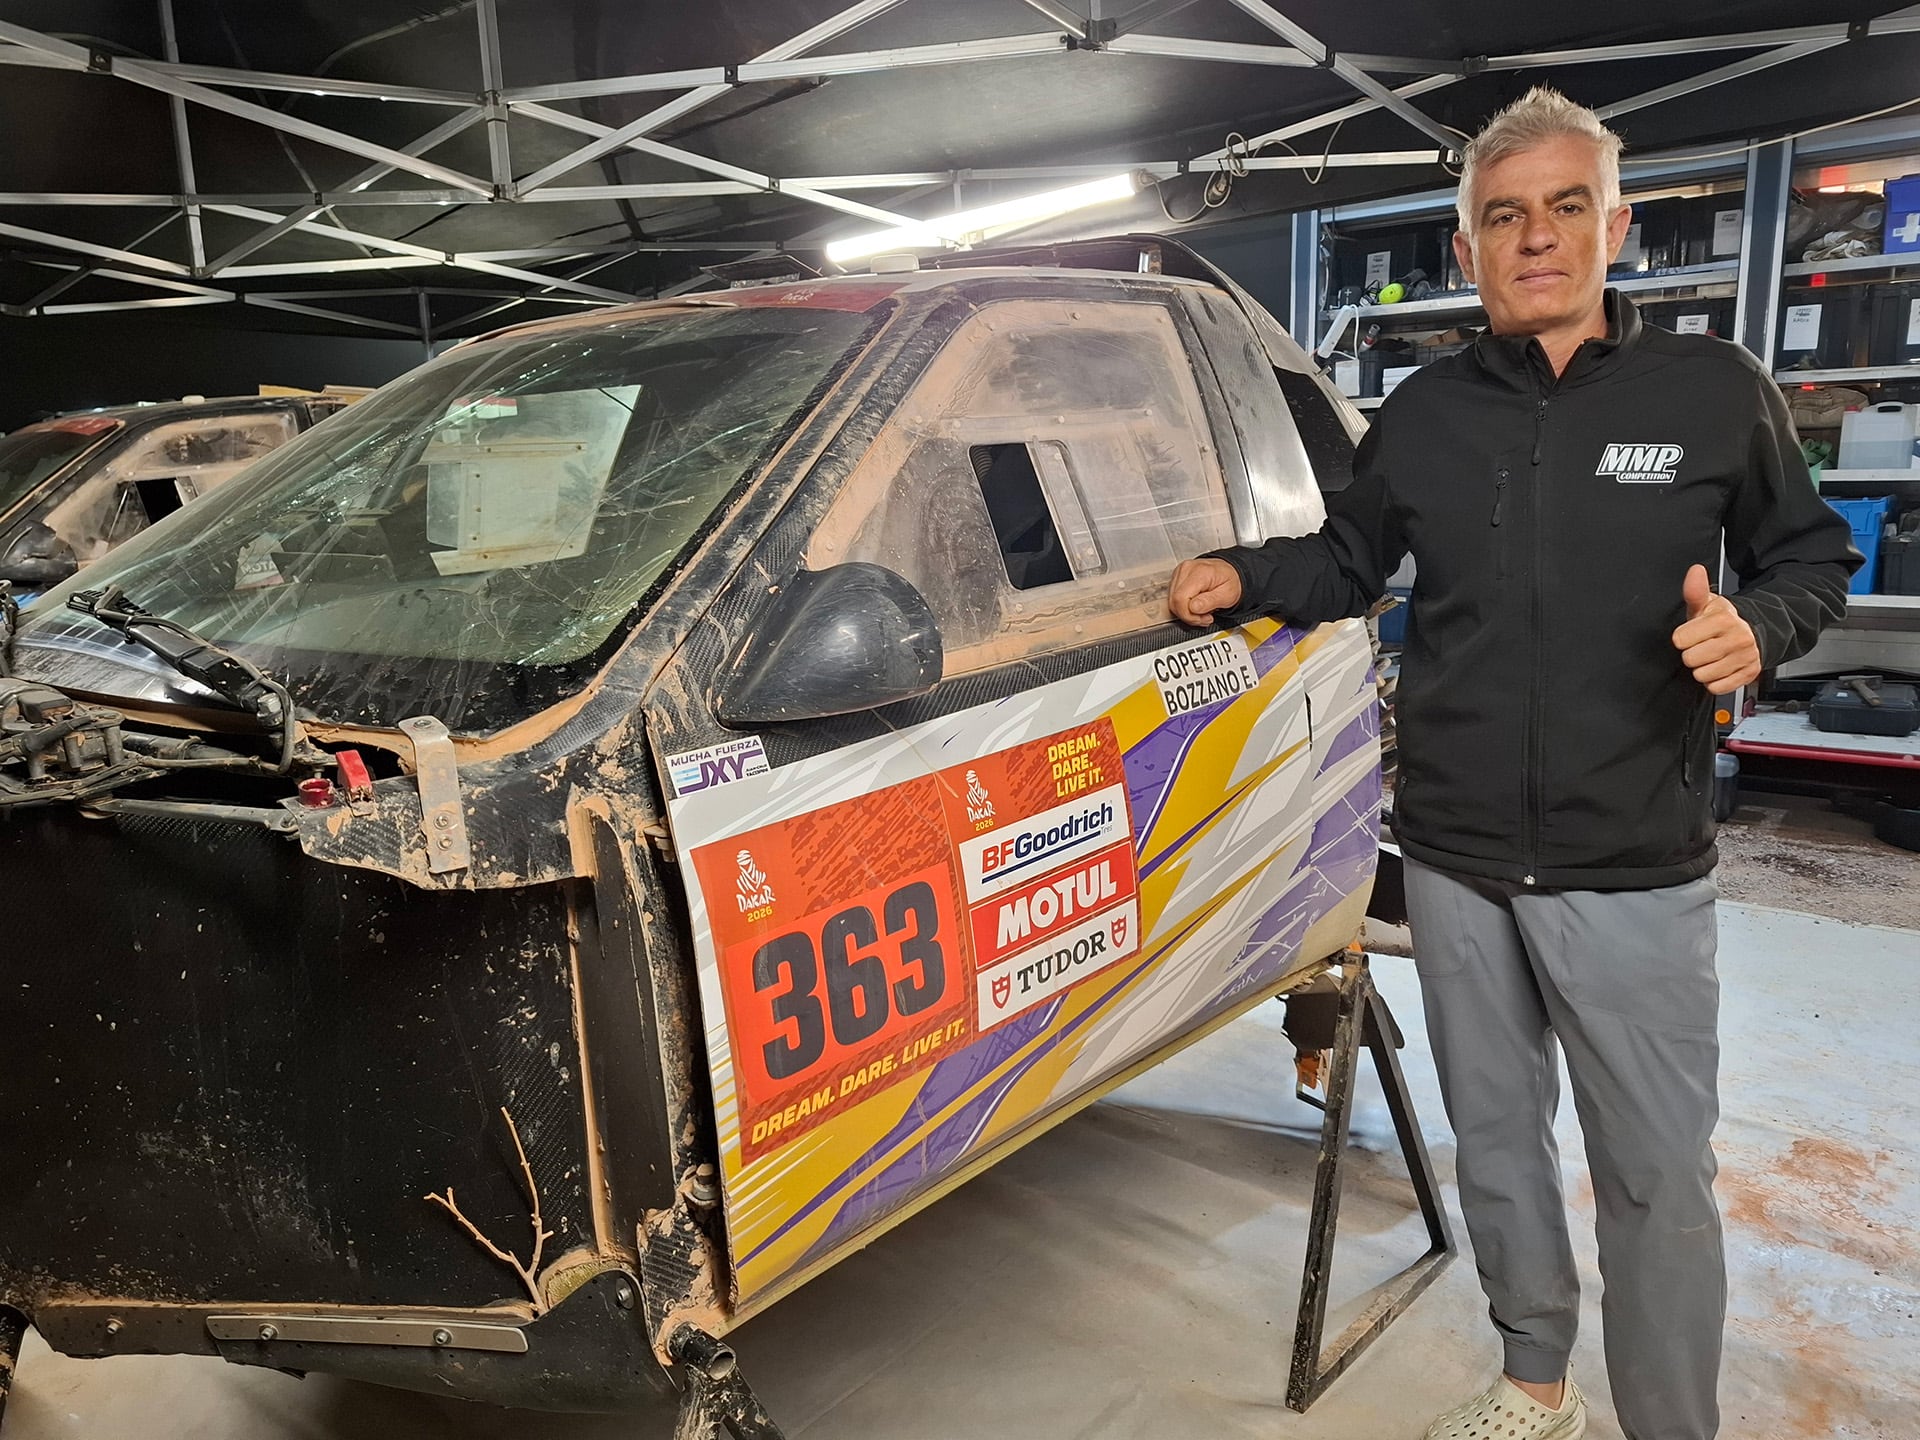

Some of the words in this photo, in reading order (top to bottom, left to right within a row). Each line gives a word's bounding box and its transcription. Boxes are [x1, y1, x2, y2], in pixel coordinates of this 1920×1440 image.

[1600, 446, 1681, 472] MMP
[1619, 472, 1672, 481] COMPETITION
[1153, 643, 1224, 683] COPETTI
[1220, 640, 1238, 664] P.
[1164, 670, 1240, 715] BOZZANO
[1239, 665, 1258, 690] E.
[670, 751, 712, 768] MUCHA
[715, 739, 760, 756] FUERZA
[1047, 732, 1101, 763] DREAM.
[678, 748, 764, 796] JXY
[1052, 753, 1094, 781] DARE.
[1056, 773, 1087, 798] LIVE
[1088, 767, 1105, 786] IT.
[966, 800, 997, 823] DAKAR
[975, 818, 995, 832] 2026
[981, 802, 1113, 874] BFGoodrich
[735, 885, 777, 913] DAKAR
[746, 905, 773, 923] 2026
[996, 859, 1118, 950] MOTUL
[1016, 930, 1107, 994] TUDOR
[752, 881, 946, 1081] 363
[751, 1086, 836, 1146] DREAM.
[839, 1053, 898, 1098] DARE.
[902, 1028, 944, 1065] LIVE
[945, 1018, 966, 1042] IT.
